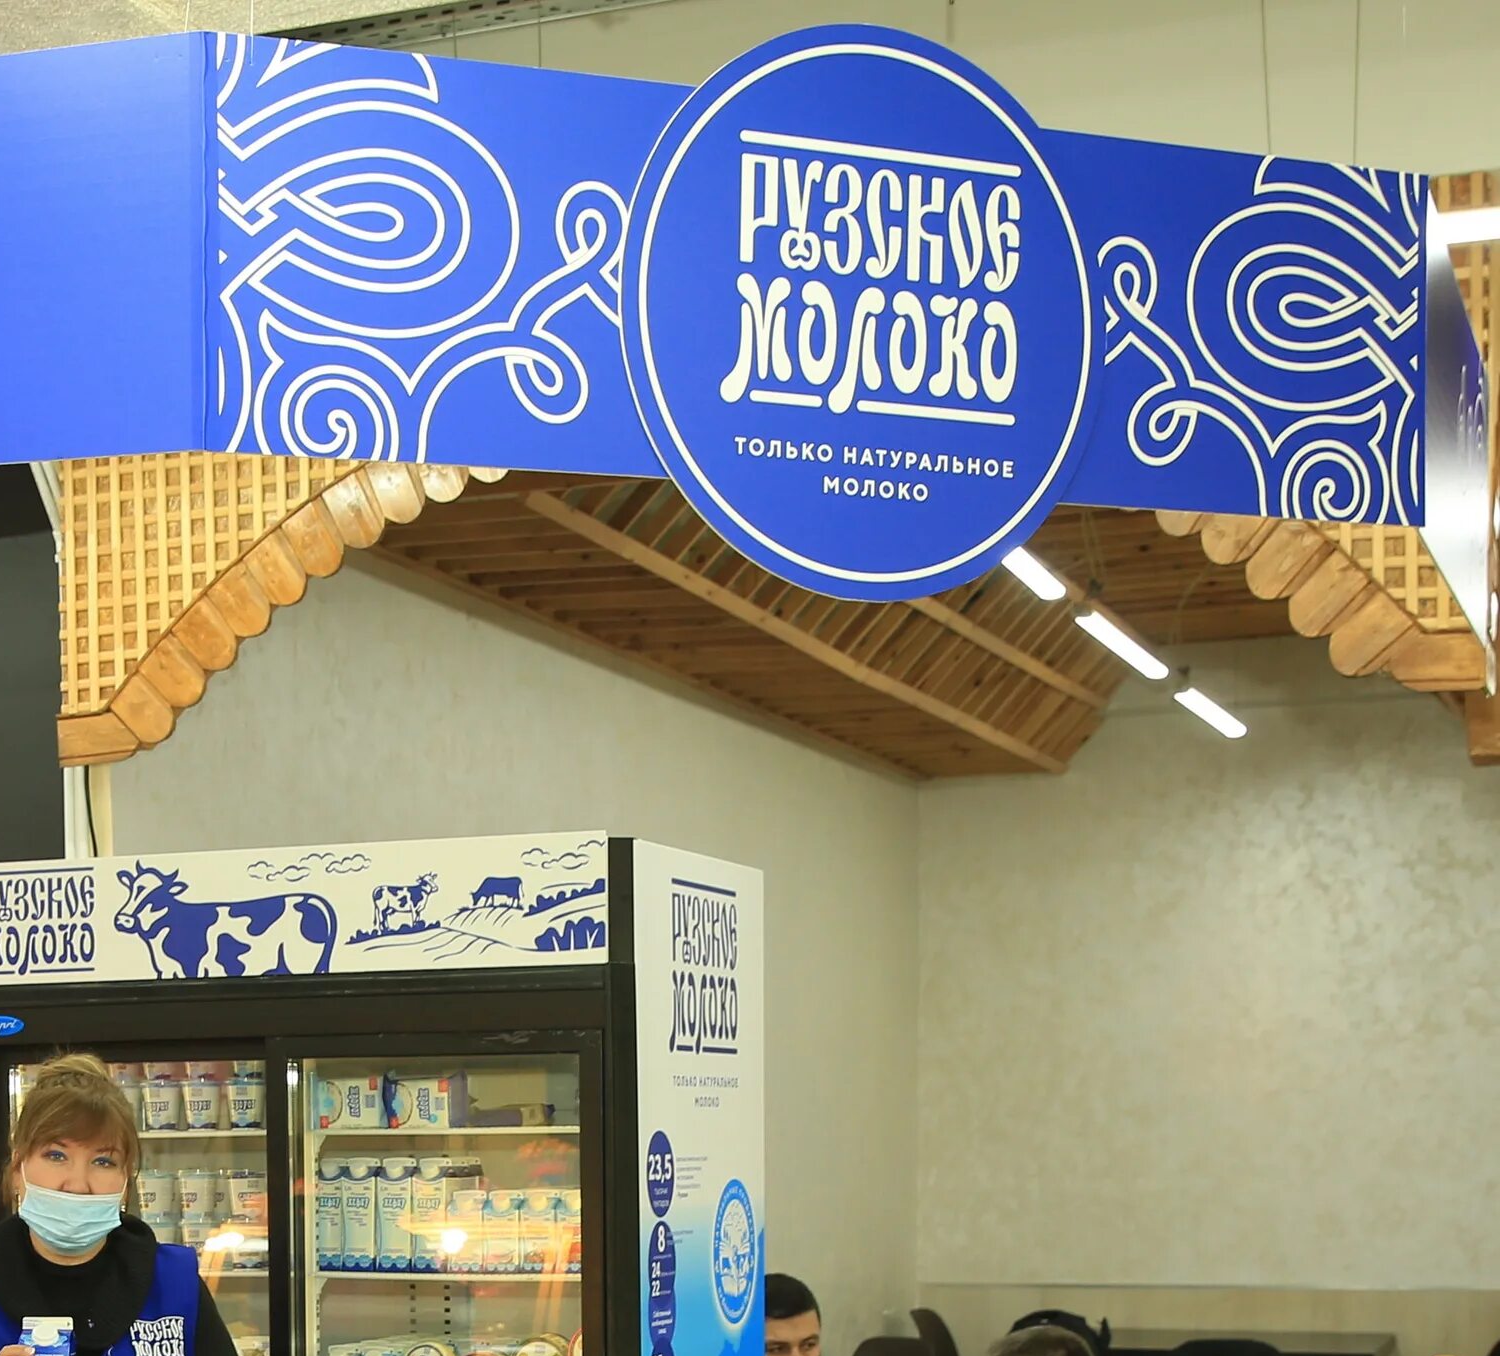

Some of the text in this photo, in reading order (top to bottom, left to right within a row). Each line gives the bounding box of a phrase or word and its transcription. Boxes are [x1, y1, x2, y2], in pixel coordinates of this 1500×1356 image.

[739, 152, 1021, 292] РУЗСКОЕ
[719, 273, 1018, 413] МОЛОКО
[734, 436, 1015, 480] ТОЛЬКО НАТУРАЛЬНОЕ
[822, 474, 930, 503] МОЛОКО
[671, 892, 737, 971] РУЗСКОЕ
[669, 969, 738, 1055] МОЛОКО
[672, 1075, 739, 1089] ТОЛЬКО НАТУРАЛЬНОЕ
[648, 1153, 672, 1184] 23,5
[657, 1225, 665, 1253] 8
